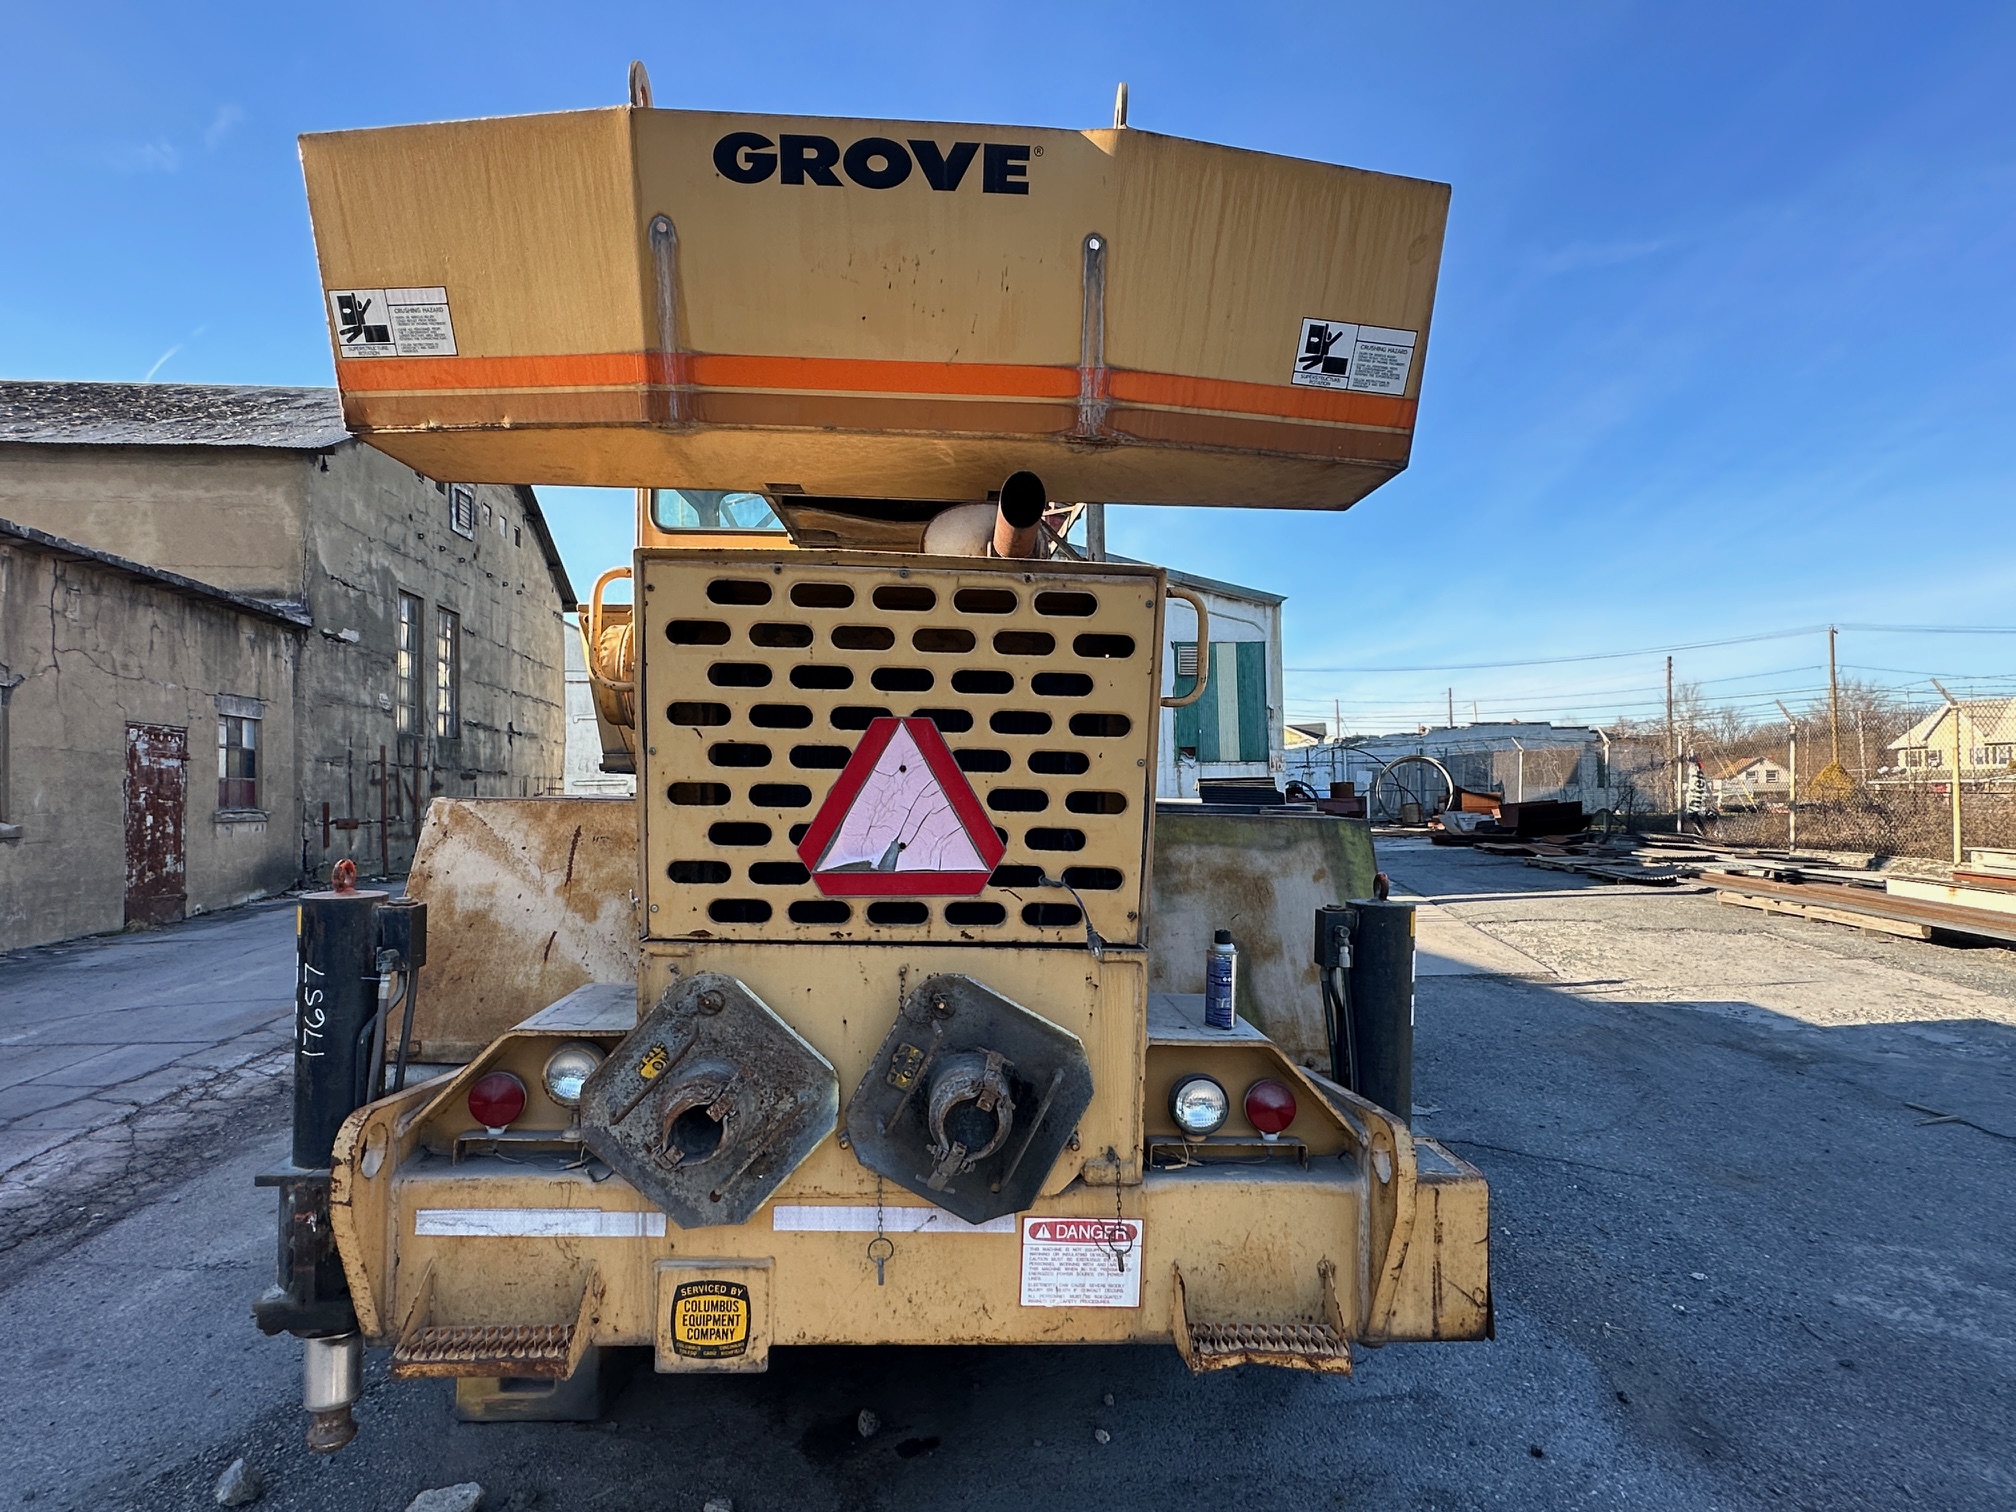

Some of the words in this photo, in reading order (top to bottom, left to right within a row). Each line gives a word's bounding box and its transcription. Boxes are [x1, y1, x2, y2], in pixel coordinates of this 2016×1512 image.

[713, 132, 1031, 195] GROVE
[1360, 344, 1387, 353] CRUSHING
[1388, 347, 1408, 355] HAZARD
[301, 962, 325, 1056] 17657
[1056, 1223, 1128, 1240] DANGER
[681, 1284, 727, 1296] SERVICED
[730, 1286, 743, 1296] BY
[684, 1300, 739, 1313] COLUMBUS
[682, 1314, 741, 1327] EQUIPMENT
[686, 1328, 735, 1341] COMPANY
